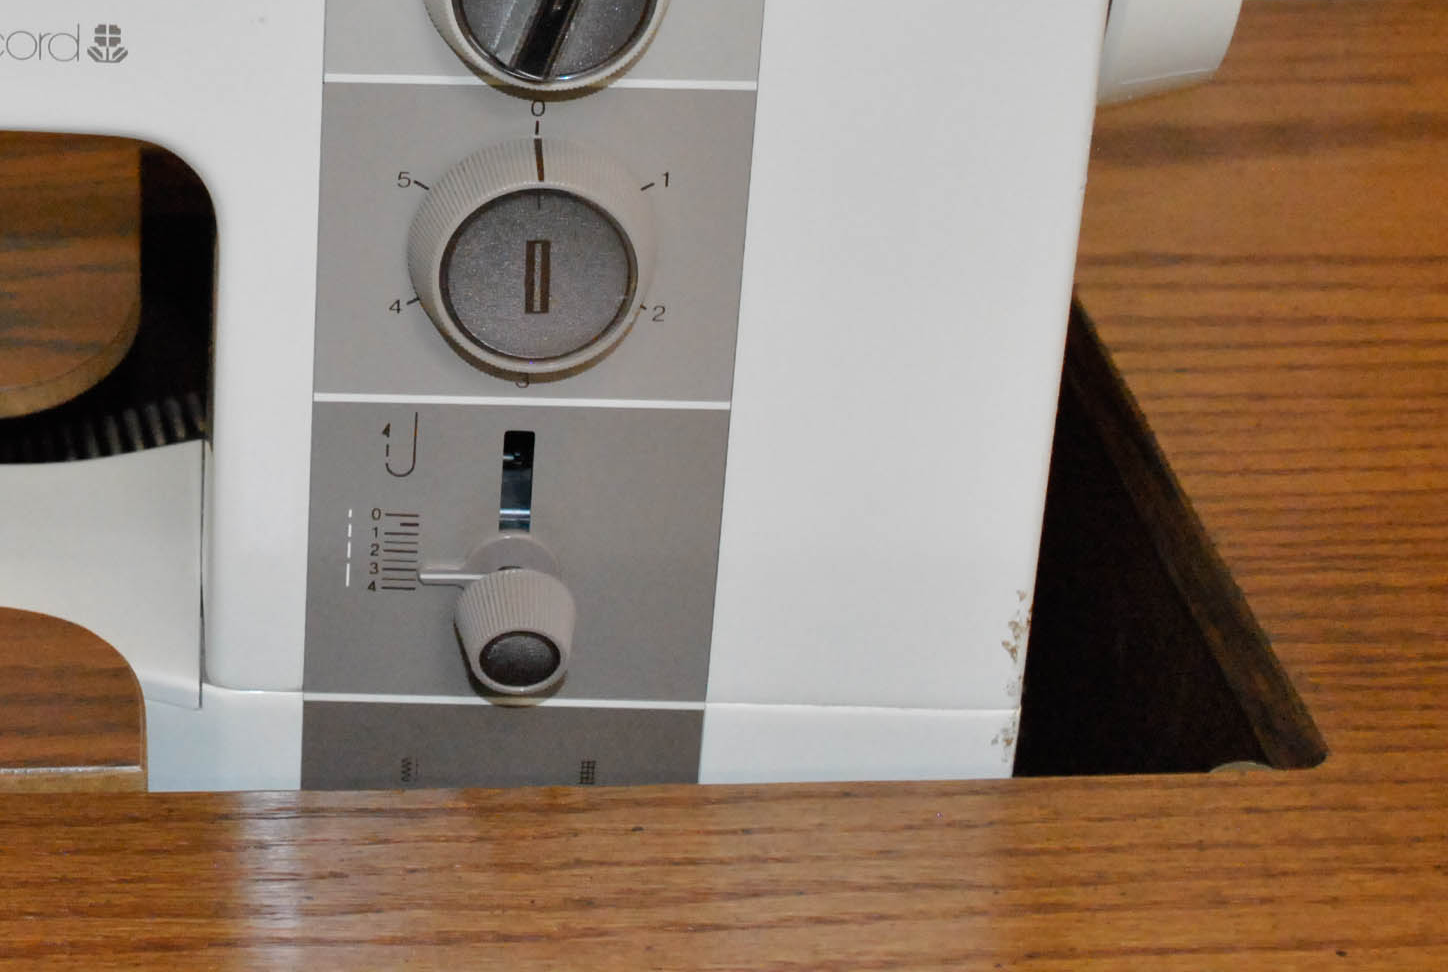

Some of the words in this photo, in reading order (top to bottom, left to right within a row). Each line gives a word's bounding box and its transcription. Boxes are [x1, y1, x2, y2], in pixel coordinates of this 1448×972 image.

[531, 100, 546, 117] 0
[397, 171, 412, 189] 5
[661, 171, 670, 188] 1
[389, 299, 402, 315] 4
[651, 304, 667, 322] 2
[371, 507, 382, 521] 0
[373, 526, 380, 538] 1
[369, 543, 381, 557] 2
[368, 562, 380, 575] 3
[367, 581, 378, 593] 4
